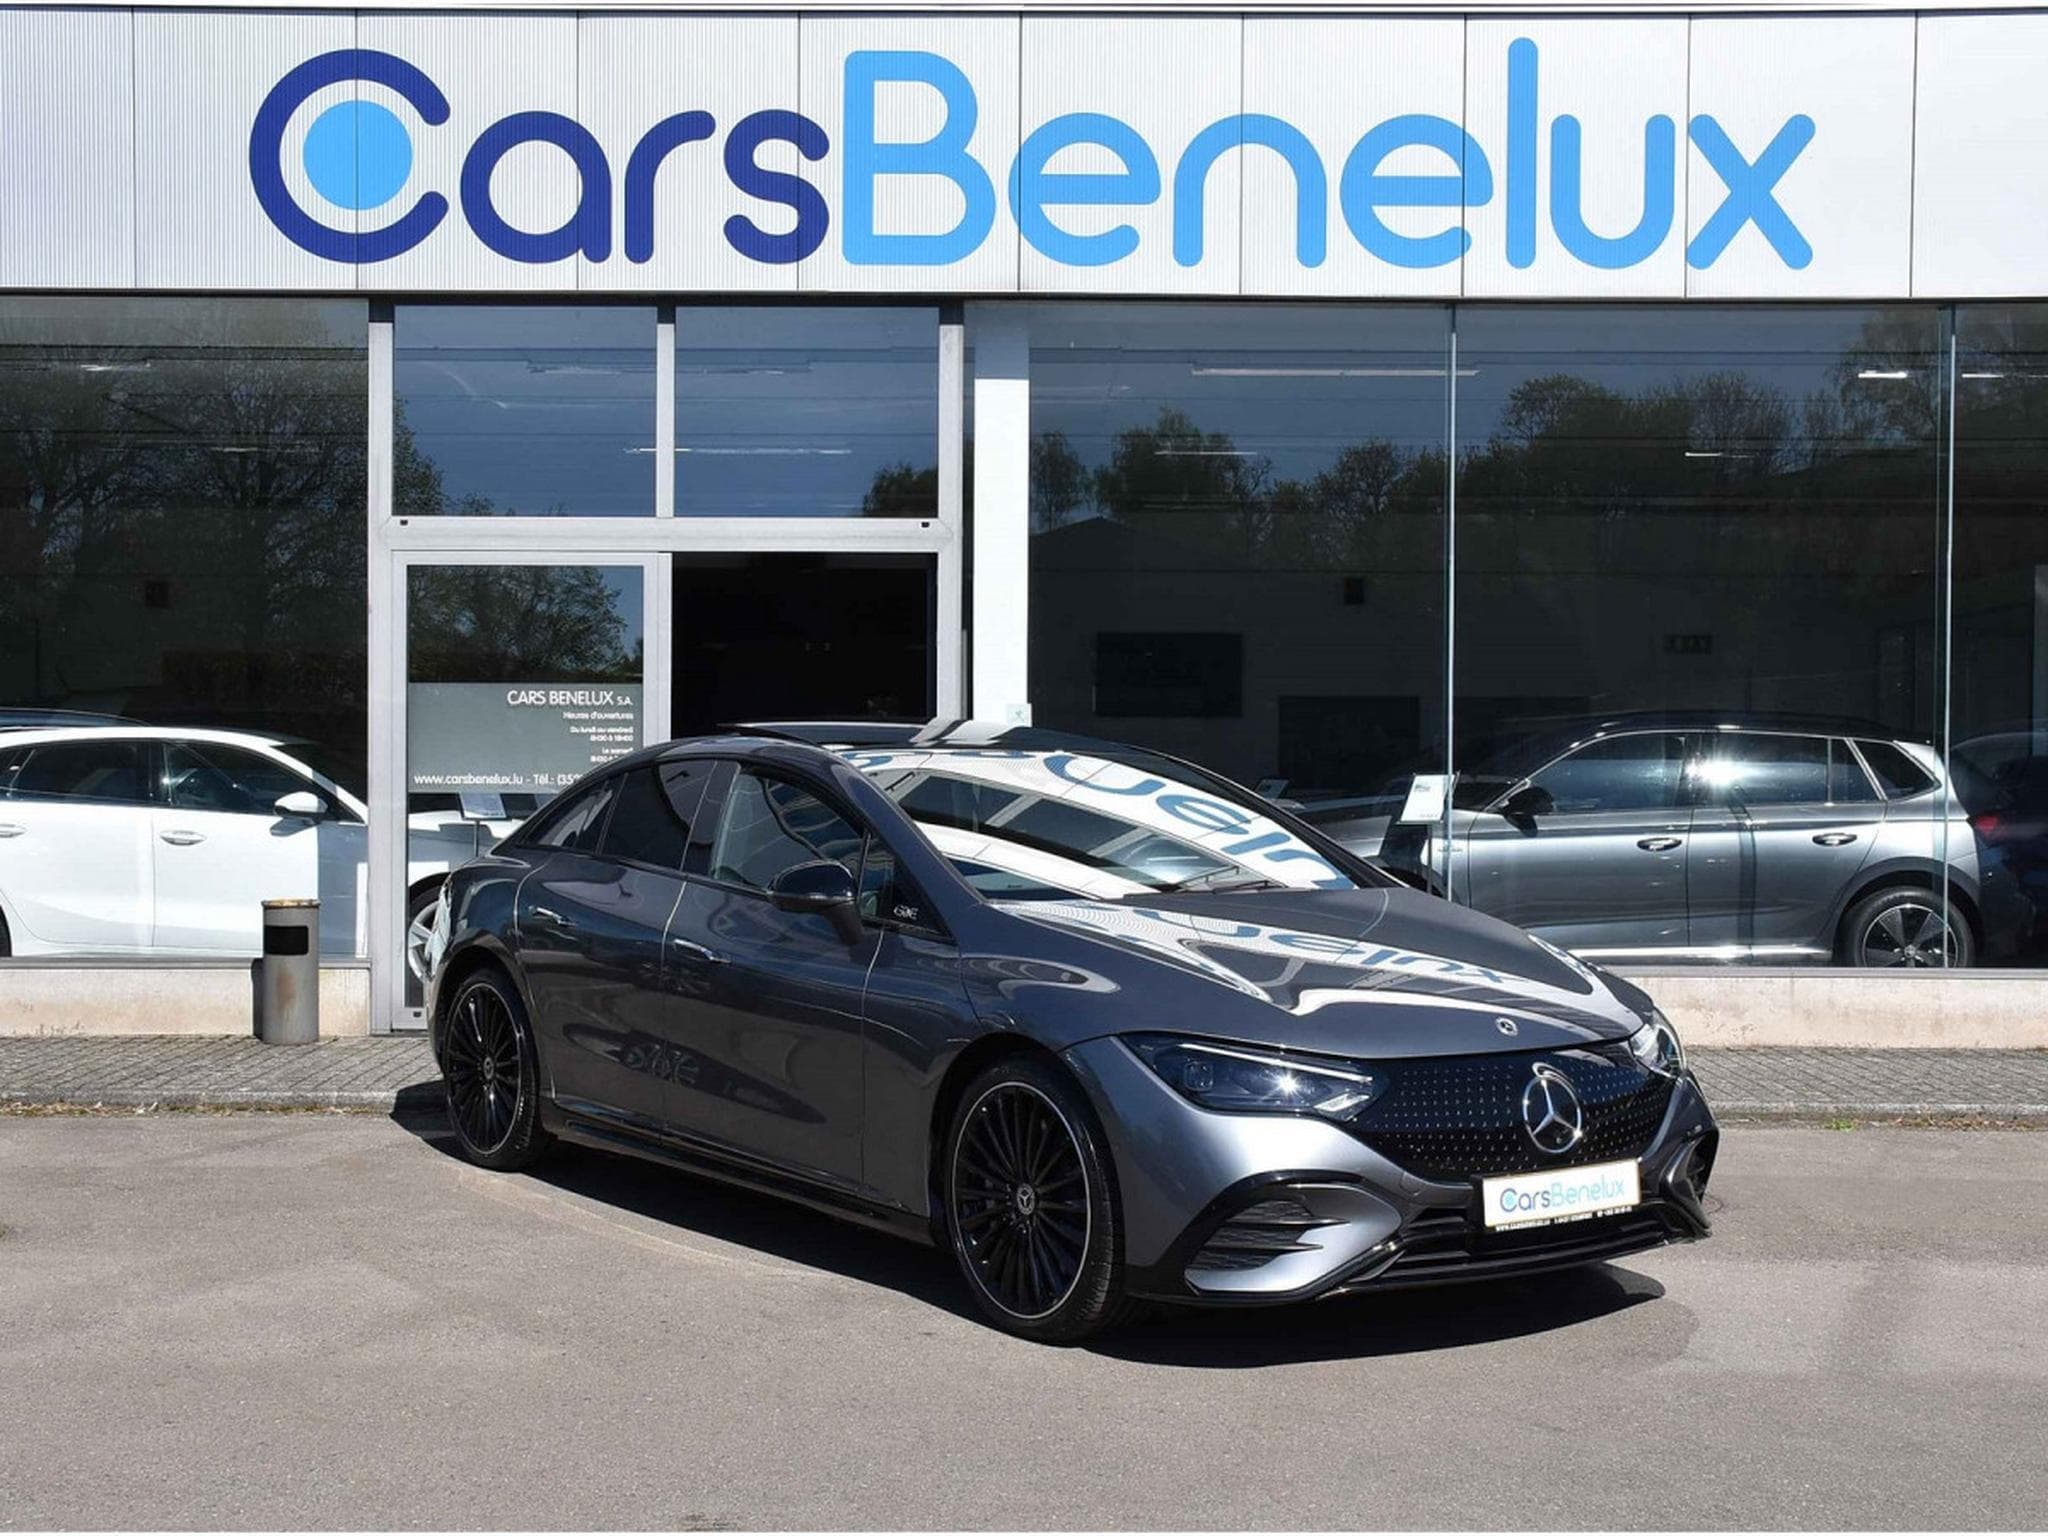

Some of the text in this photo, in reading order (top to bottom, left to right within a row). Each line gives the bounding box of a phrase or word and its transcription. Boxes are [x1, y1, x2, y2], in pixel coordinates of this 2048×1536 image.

[507, 690, 546, 705] CARS
[549, 690, 614, 705] BENELUX
[414, 773, 523, 785] www.carsbenelux.lu
